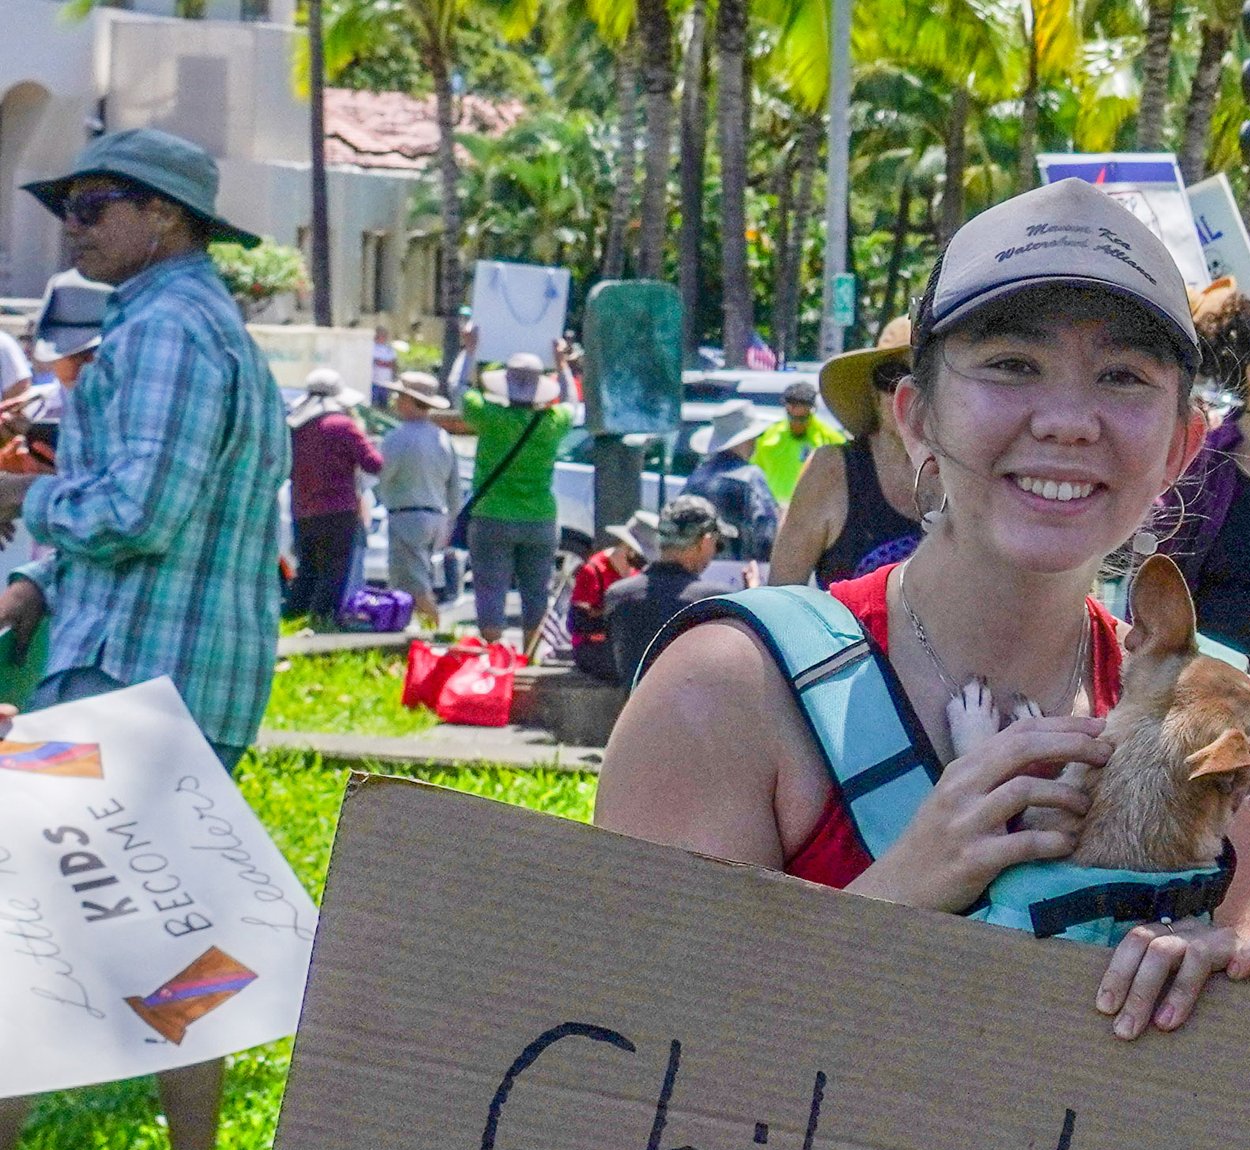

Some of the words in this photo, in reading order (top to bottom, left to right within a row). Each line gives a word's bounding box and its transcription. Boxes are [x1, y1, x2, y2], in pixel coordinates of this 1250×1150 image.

[994, 235, 1089, 263] Watershed
[1093, 243, 1158, 286] Alliance
[1026, 223, 1092, 237] Mauna
[1098, 227, 1132, 251] Kea
[42, 825, 139, 923] KIDS
[88, 797, 214, 939] BECOME
[175, 775, 316, 941] Leaders
